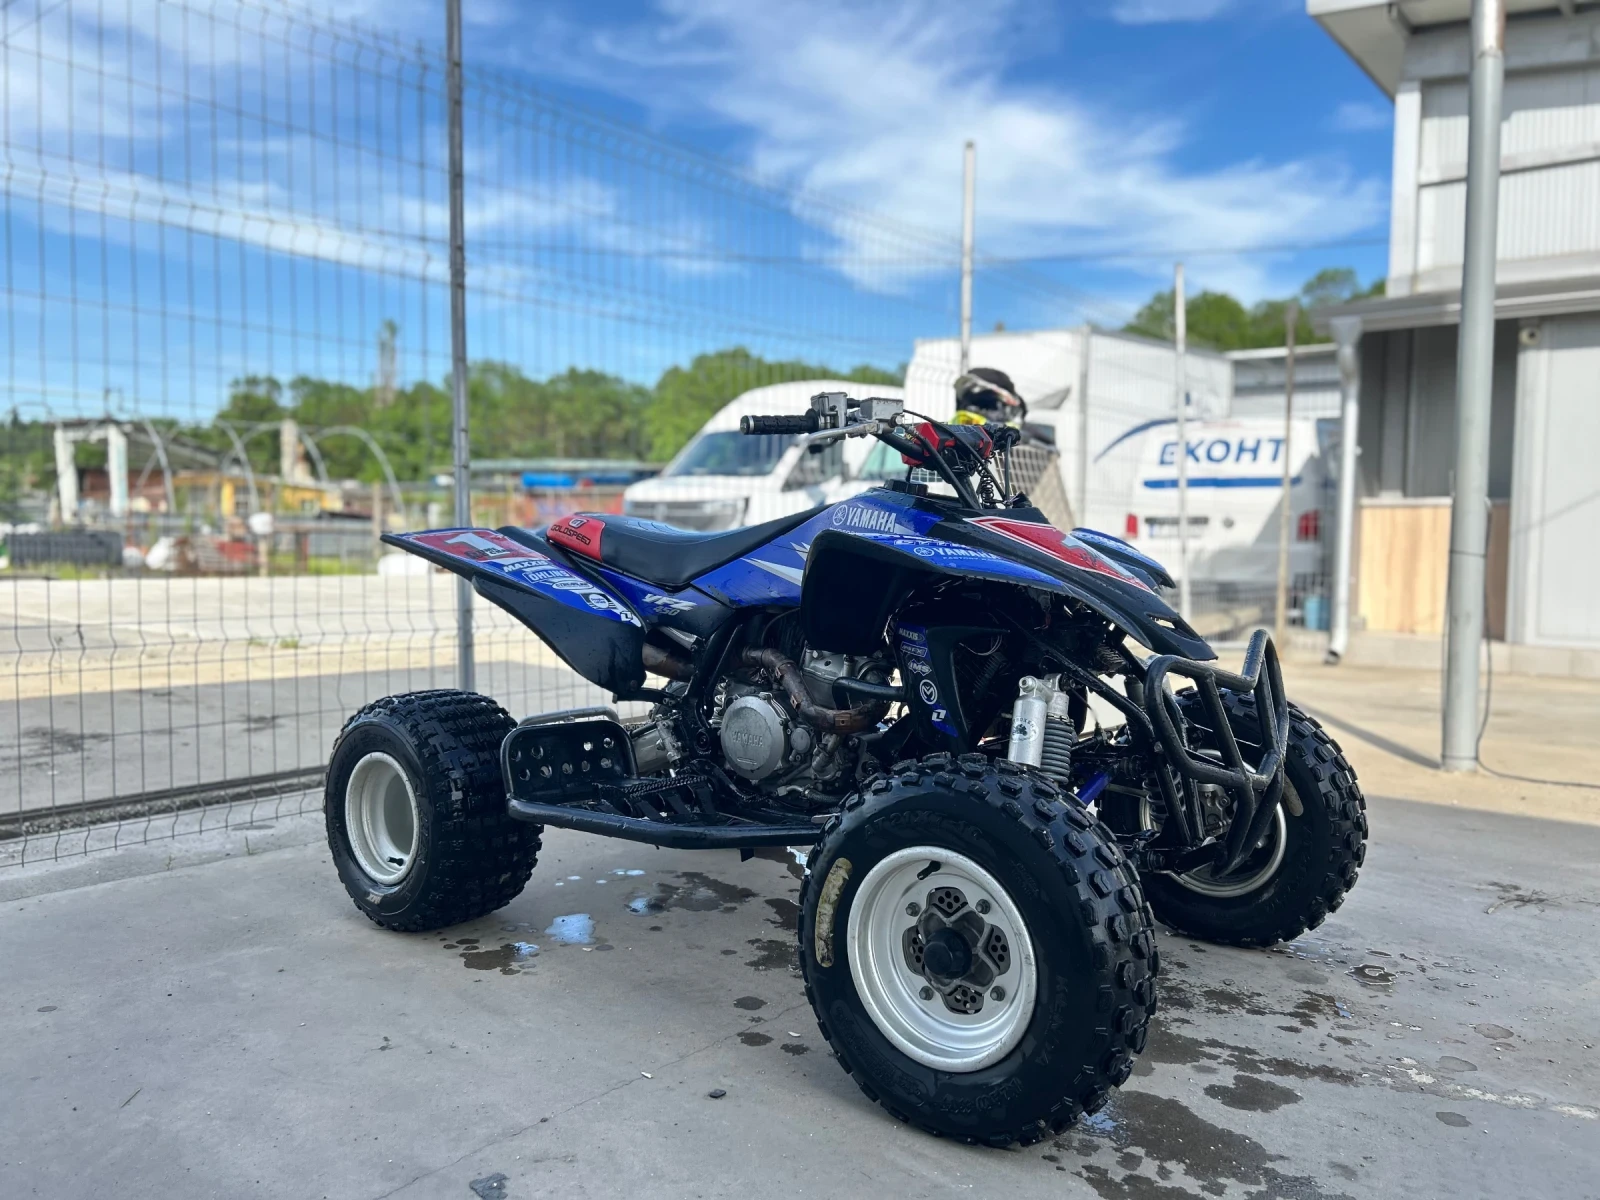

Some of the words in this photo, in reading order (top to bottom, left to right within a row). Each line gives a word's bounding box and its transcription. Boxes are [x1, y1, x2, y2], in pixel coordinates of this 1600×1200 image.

[846, 507, 897, 532] YAMAHA
[550, 524, 591, 546] GOLDSPEED
[933, 547, 1001, 559] YAMAHA
[502, 560, 549, 573] MAXXIS
[653, 605, 681, 616] 450
[898, 628, 919, 640] MAXXIS
[909, 662, 929, 672] IMS
[732, 730, 764, 747] YAMAHA
